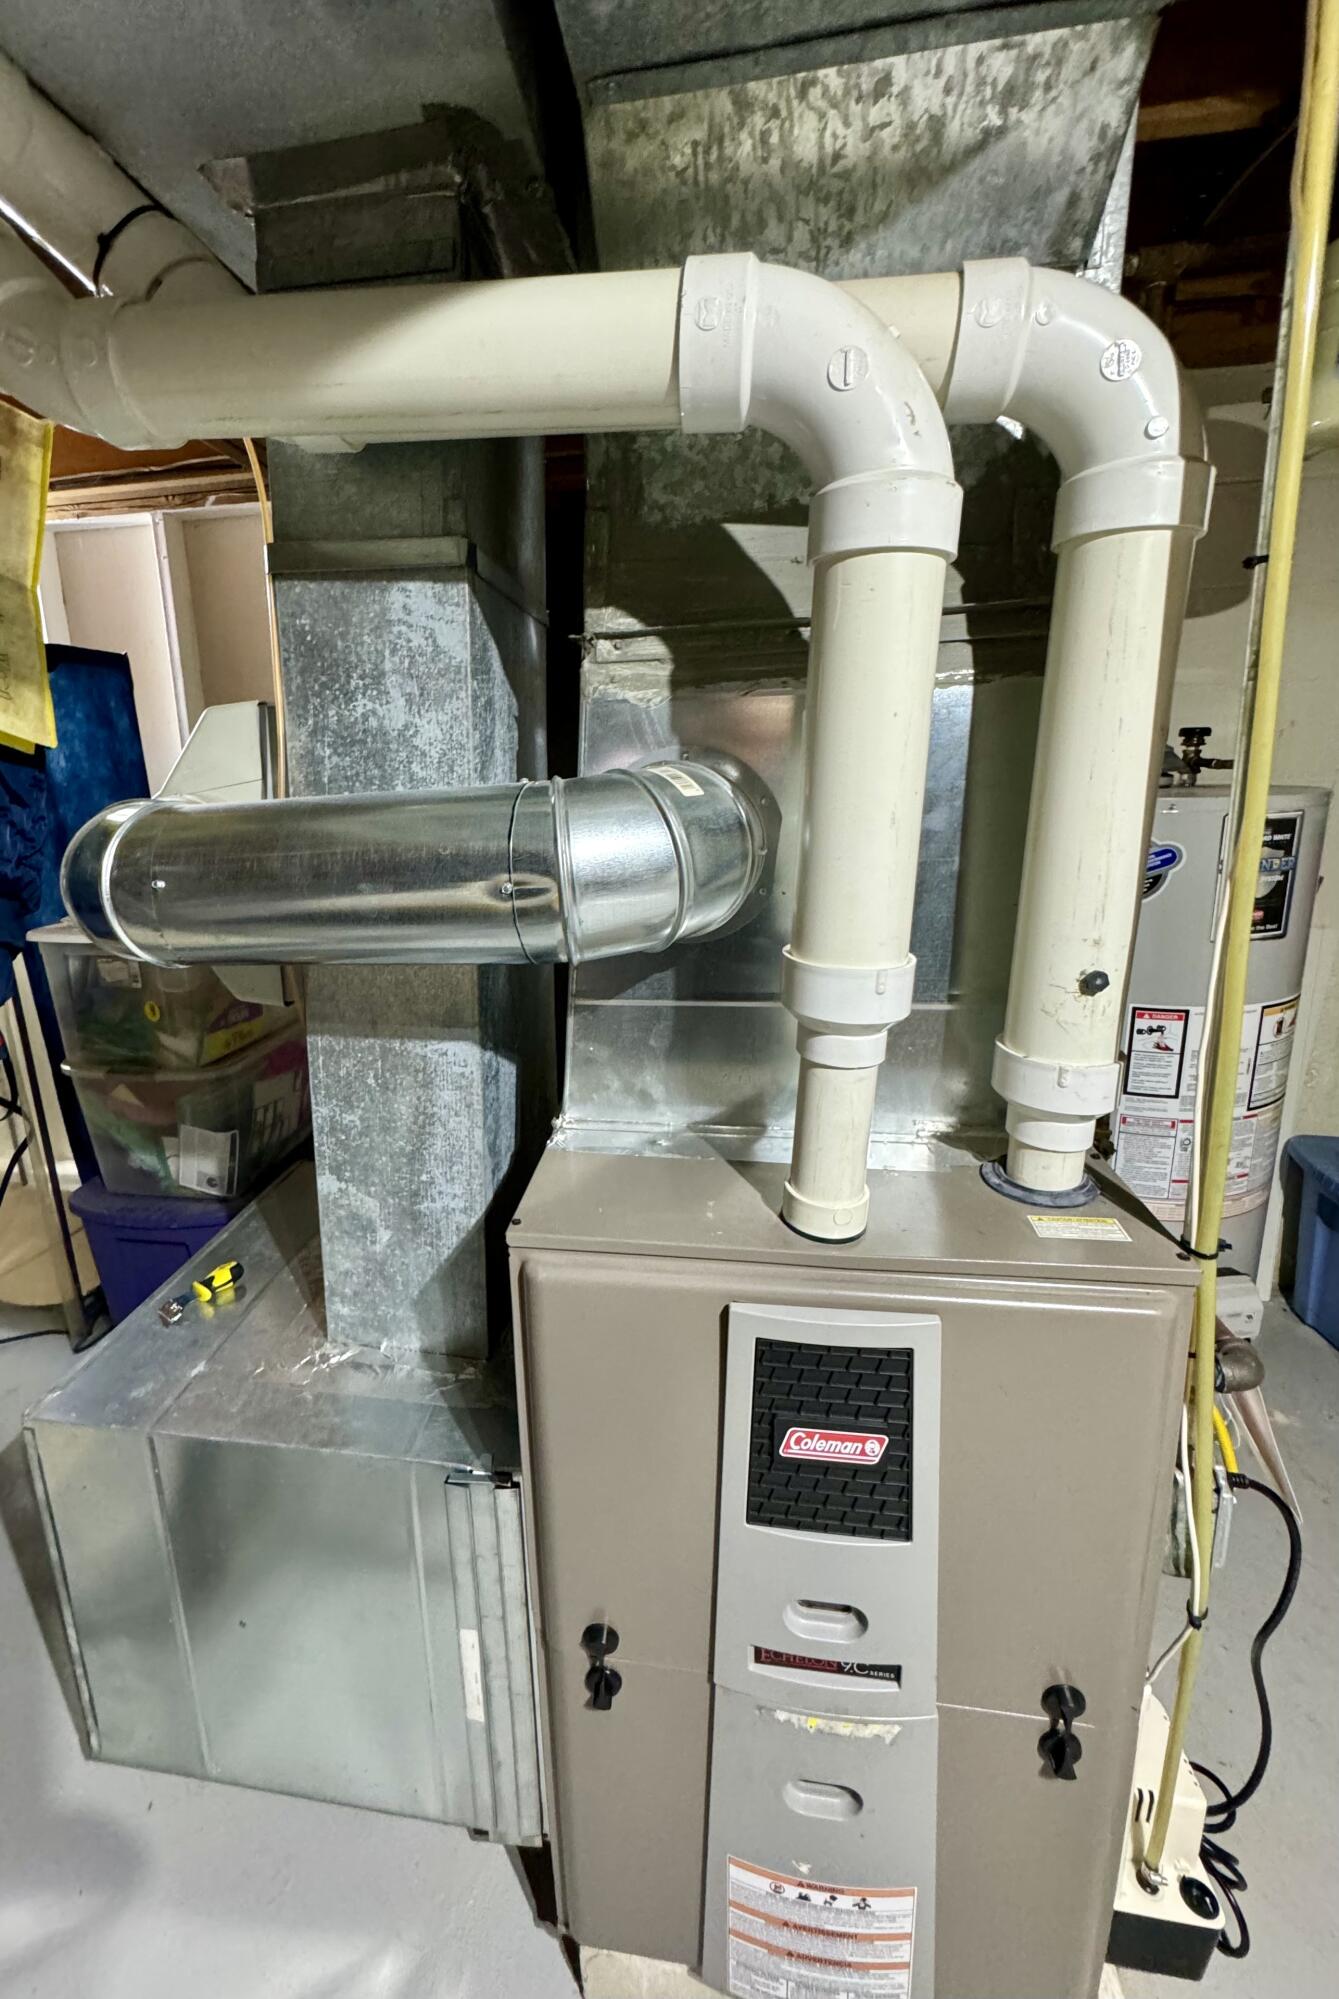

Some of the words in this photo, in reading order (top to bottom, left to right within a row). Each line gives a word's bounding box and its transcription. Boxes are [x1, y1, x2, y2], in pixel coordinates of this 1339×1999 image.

[1261, 857, 1296, 871] NDER
[790, 1431, 863, 1455] Coleman
[869, 1670, 896, 1679] SERIES
[806, 1882, 845, 1894] WARNING
